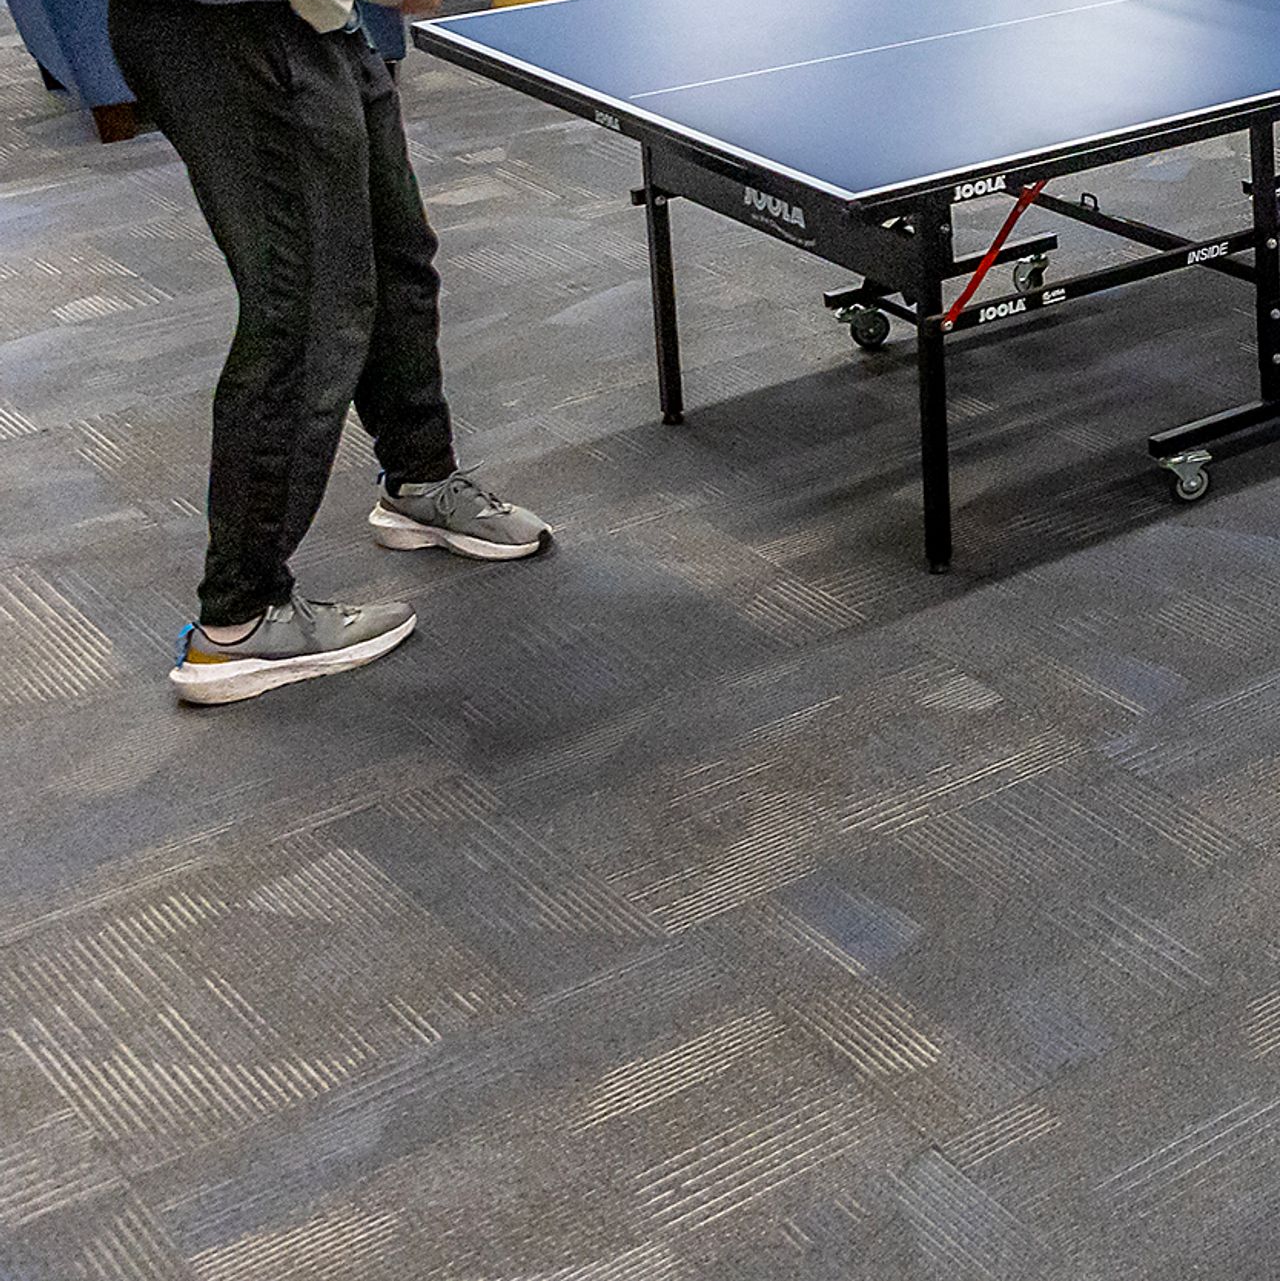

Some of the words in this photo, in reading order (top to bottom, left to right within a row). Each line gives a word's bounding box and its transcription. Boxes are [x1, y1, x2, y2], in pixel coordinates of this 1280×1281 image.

[953, 174, 1006, 202] JOOLA
[743, 186, 806, 229] JOOLA
[1187, 242, 1229, 265] INSIDE
[979, 297, 1027, 324] JOOLA
